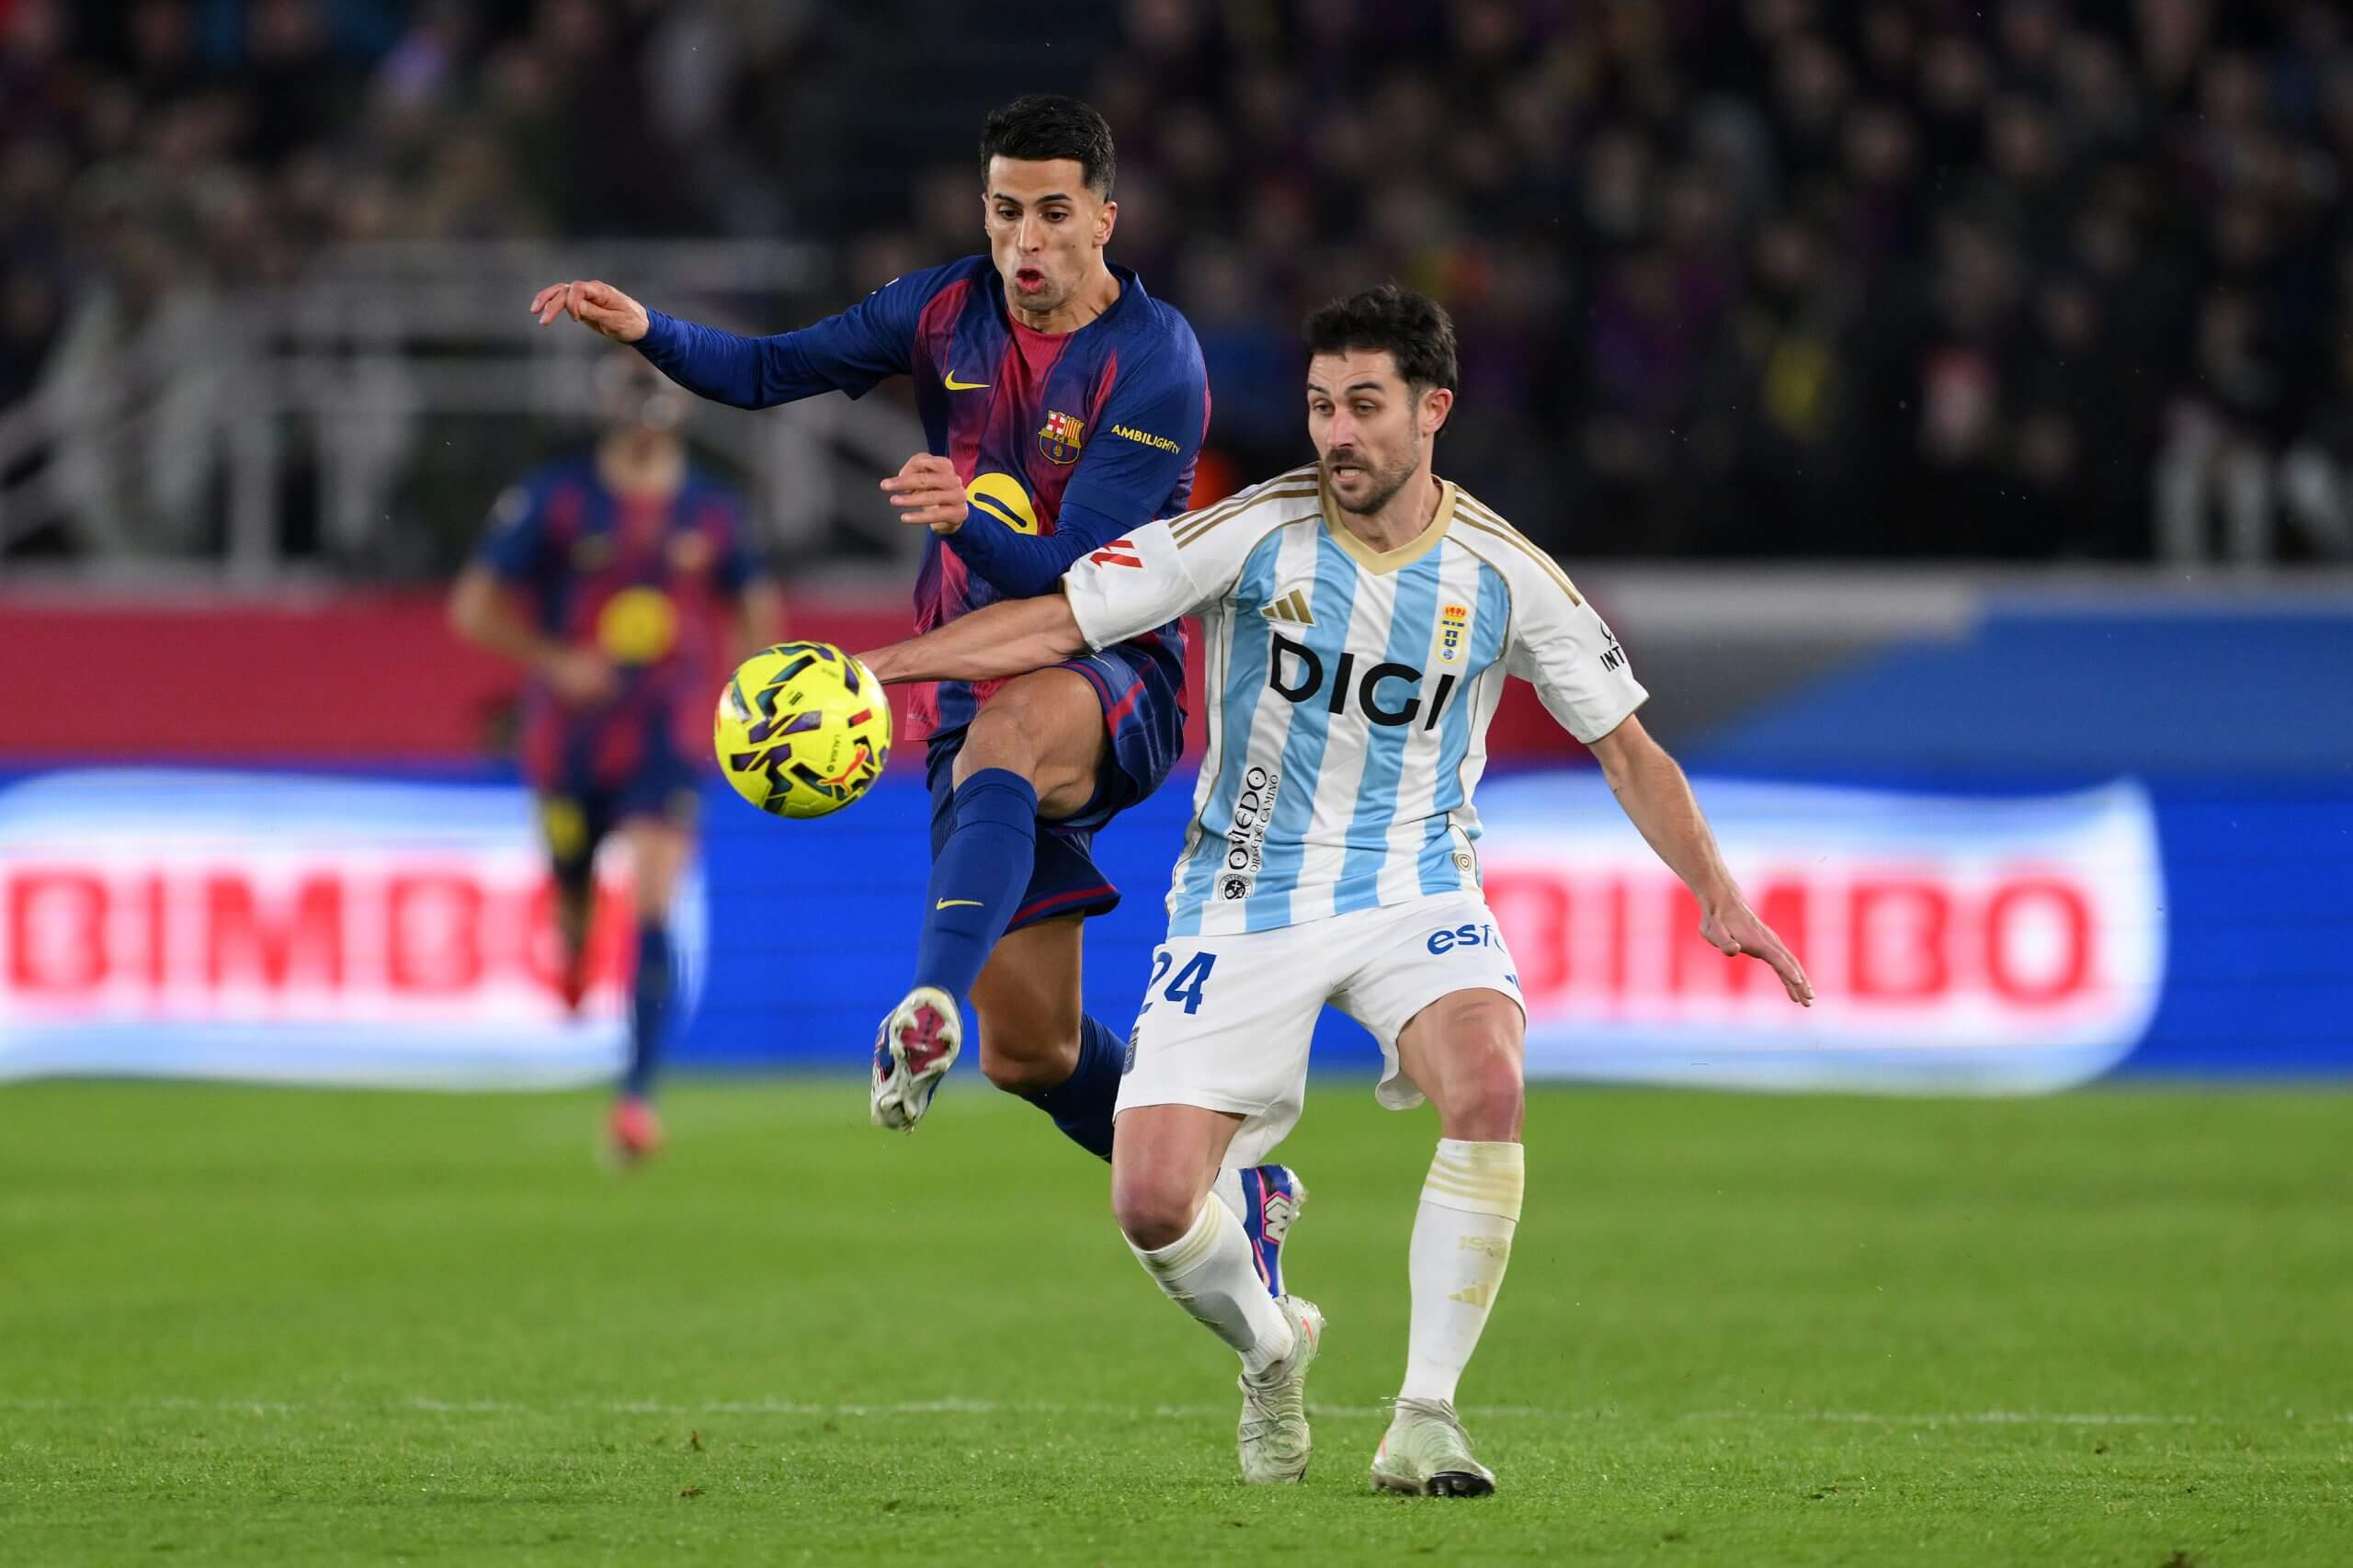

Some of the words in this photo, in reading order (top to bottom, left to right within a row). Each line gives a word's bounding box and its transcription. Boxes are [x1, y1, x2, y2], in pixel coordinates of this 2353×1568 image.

[1269, 631, 1456, 732] DIGI
[1142, 950, 1217, 1015] 24
[1482, 875, 2094, 1006] BIMBO
